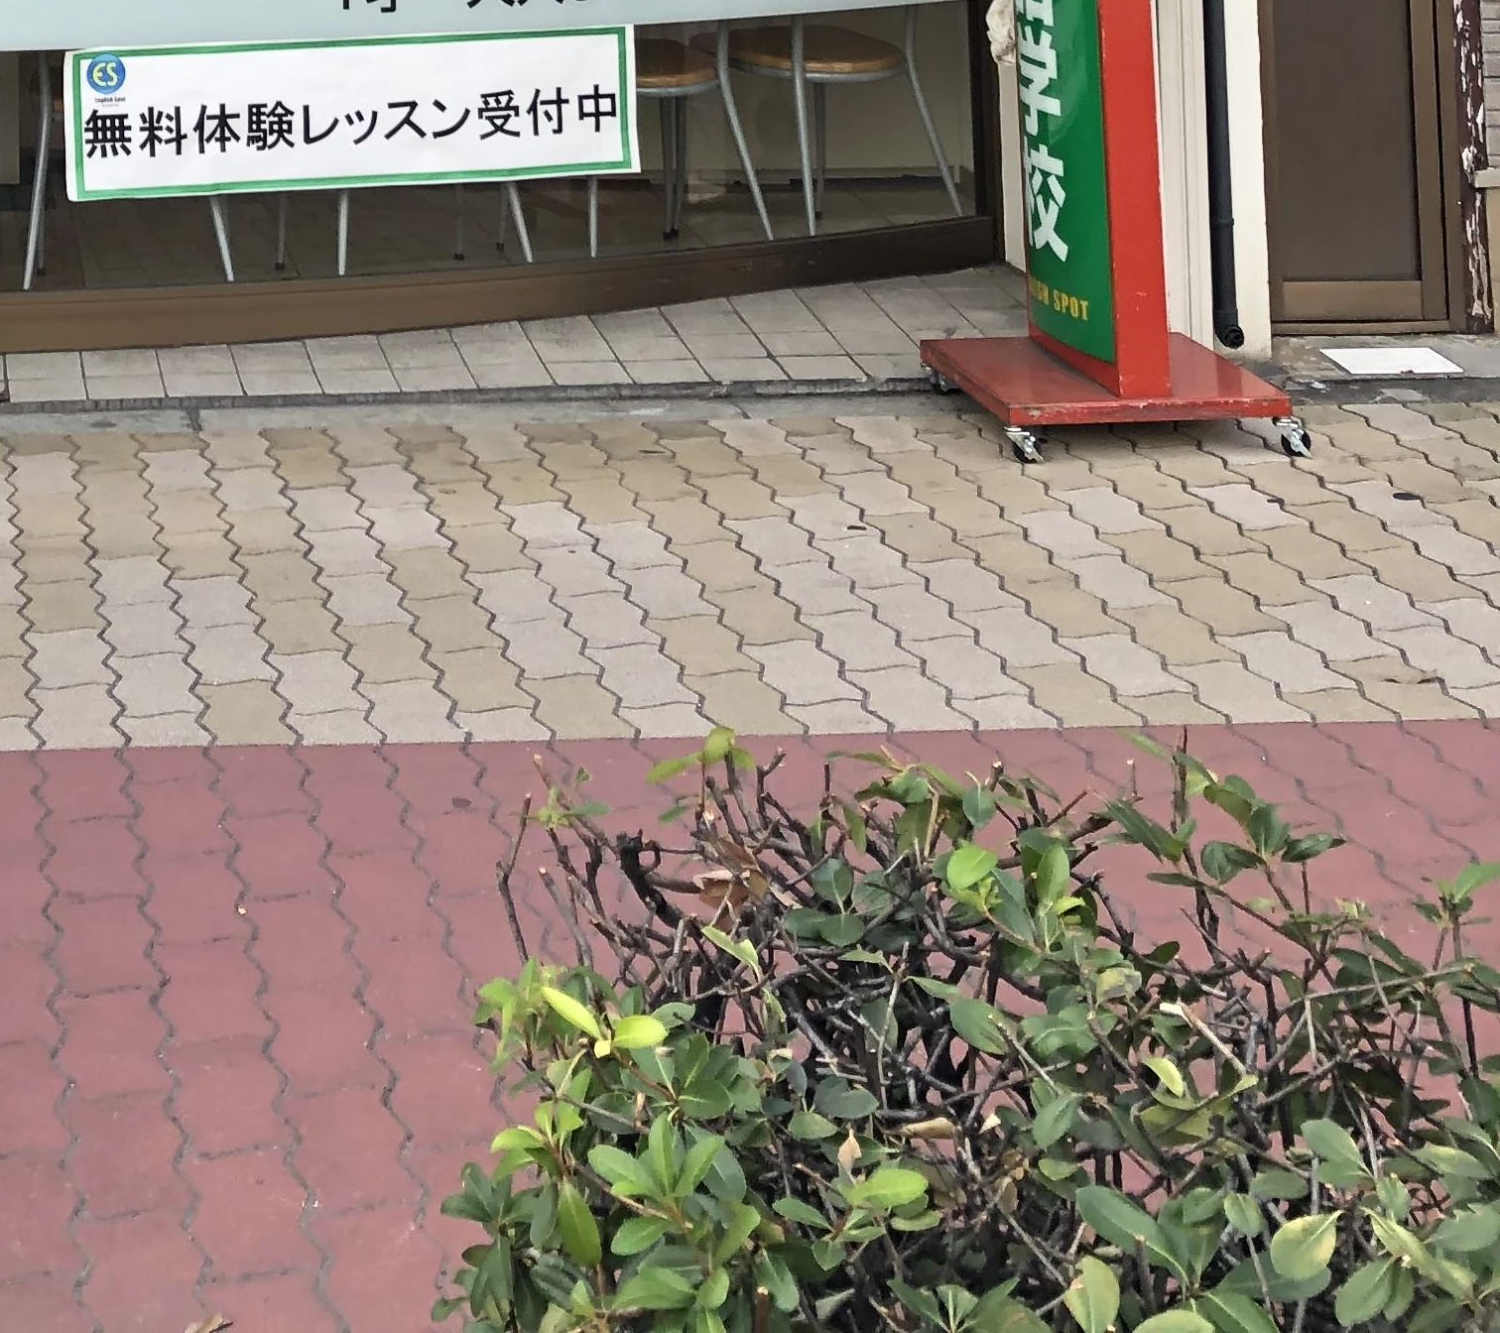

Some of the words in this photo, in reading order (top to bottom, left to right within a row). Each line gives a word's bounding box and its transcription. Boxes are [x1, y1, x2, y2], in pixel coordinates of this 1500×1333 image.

[92, 61, 118, 86] ES
[83, 84, 618, 159] 無料体験レッスン受付中
[1053, 288, 1090, 322] SPOT
